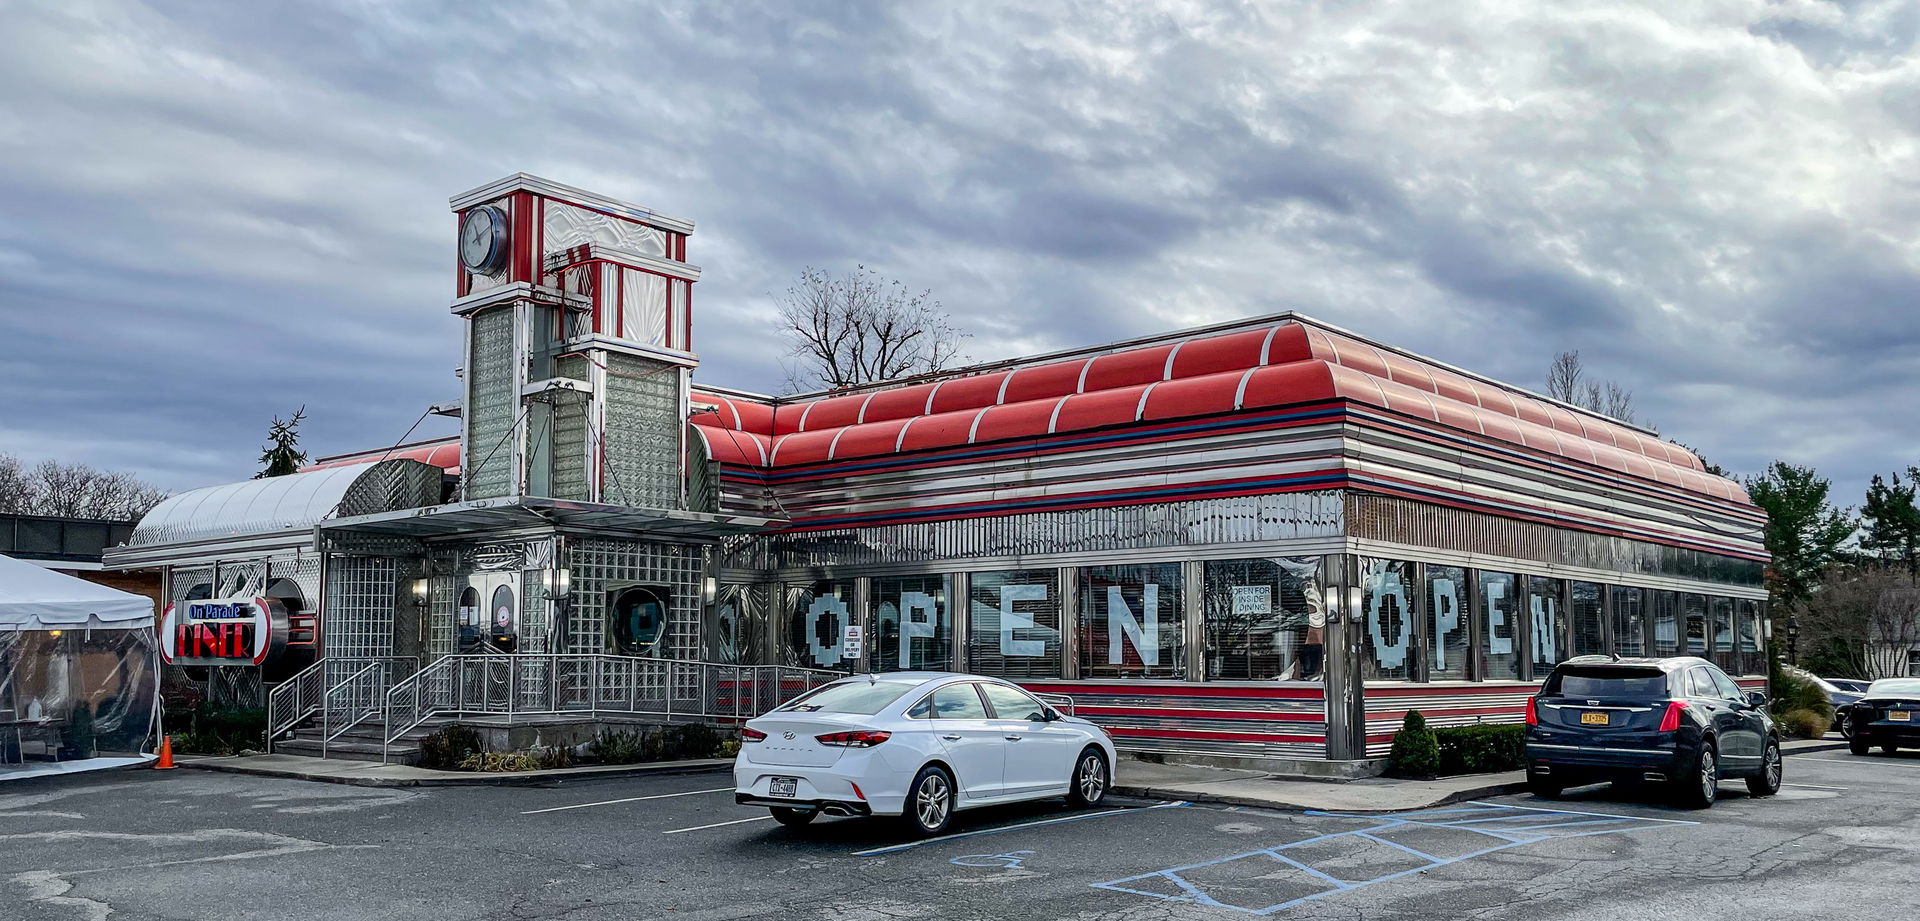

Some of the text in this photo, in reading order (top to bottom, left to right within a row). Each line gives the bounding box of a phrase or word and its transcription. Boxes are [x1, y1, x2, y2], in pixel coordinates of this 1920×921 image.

[1232, 586, 1270, 595] OPEN FOR
[1239, 595, 1264, 603] INSIDE
[189, 604, 241, 619] On Parade
[1239, 603, 1265, 611] DINING
[805, 584, 1159, 668] OPEN
[1368, 571, 1556, 669] OPEN
[176, 622, 252, 658] DINER
